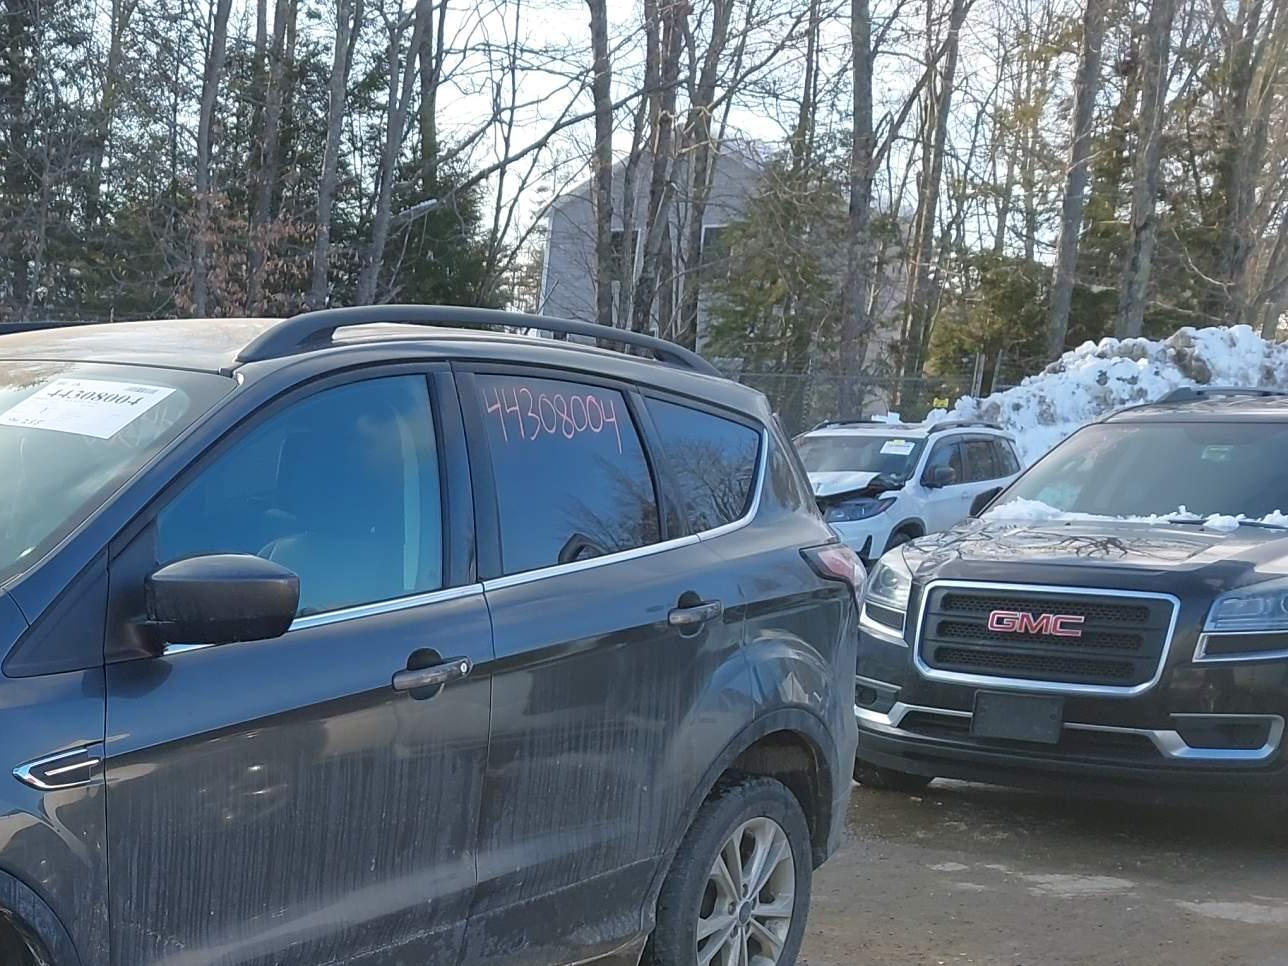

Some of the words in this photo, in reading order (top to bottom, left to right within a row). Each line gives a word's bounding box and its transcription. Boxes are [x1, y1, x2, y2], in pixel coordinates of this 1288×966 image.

[47, 388, 144, 406] 44308004
[482, 387, 622, 455] 44308004
[988, 610, 1085, 637] GMC
